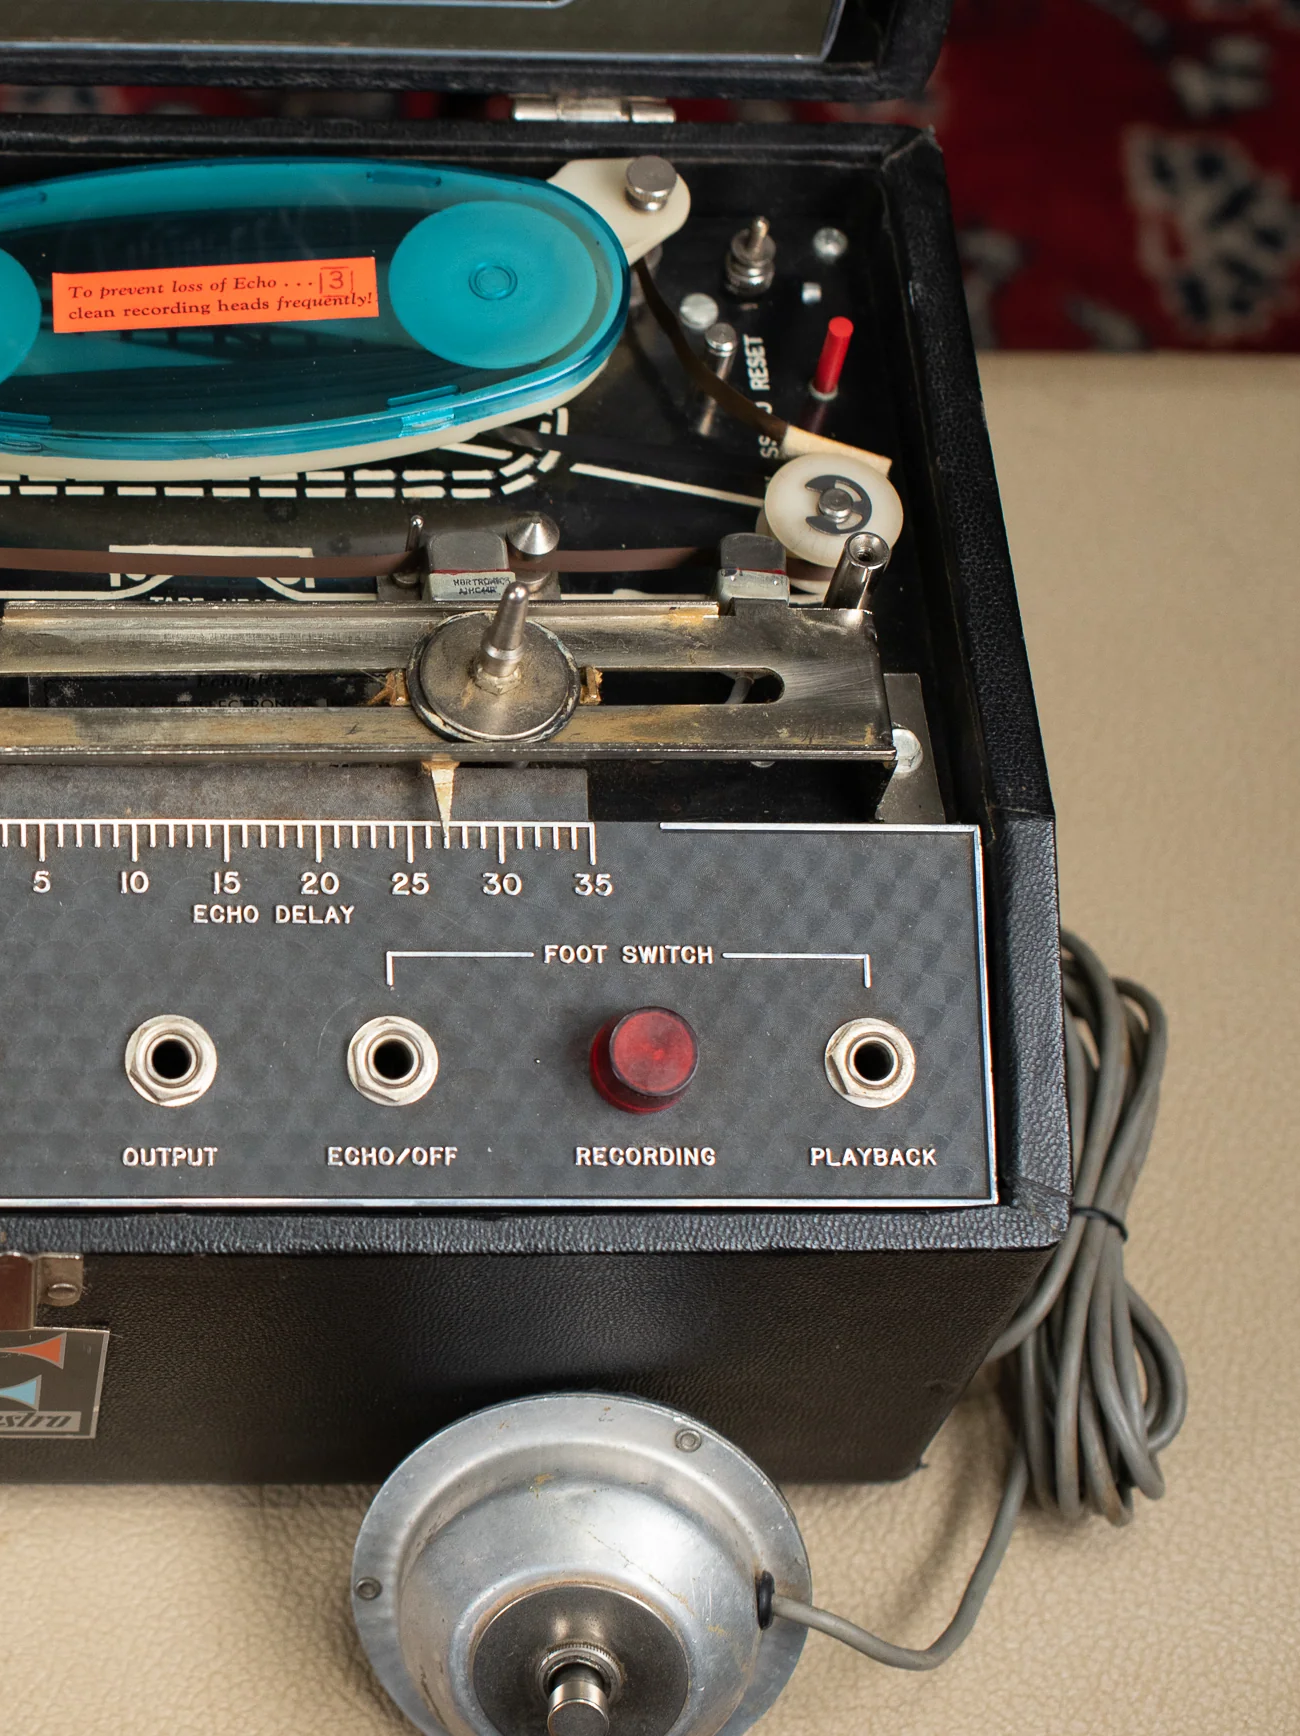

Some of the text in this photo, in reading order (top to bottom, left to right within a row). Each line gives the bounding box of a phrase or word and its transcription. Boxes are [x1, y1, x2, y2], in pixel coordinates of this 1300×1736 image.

[67, 285, 93, 299] To
[99, 282, 164, 300] prevent
[172, 280, 203, 294] loss
[209, 277, 230, 293] of
[233, 275, 277, 291] Echo
[68, 291, 373, 321] clean recording heads frequently!
[742, 333, 771, 391] RESET
[32, 870, 51, 894] 5
[120, 870, 150, 894] 10
[213, 871, 241, 895] 15
[300, 871, 340, 895] 20
[391, 872, 430, 896] 25
[482, 872, 522, 896] 30
[574, 872, 613, 897] 35
[193, 904, 355, 925] ECHO DELAY
[543, 944, 714, 965] FOOT SWITCH
[122, 1146, 219, 1167] OUTPUT
[327, 1146, 458, 1167] ECHO/OFF
[575, 1146, 716, 1167] RECORDING
[810, 1147, 937, 1167] PLAYBACK
